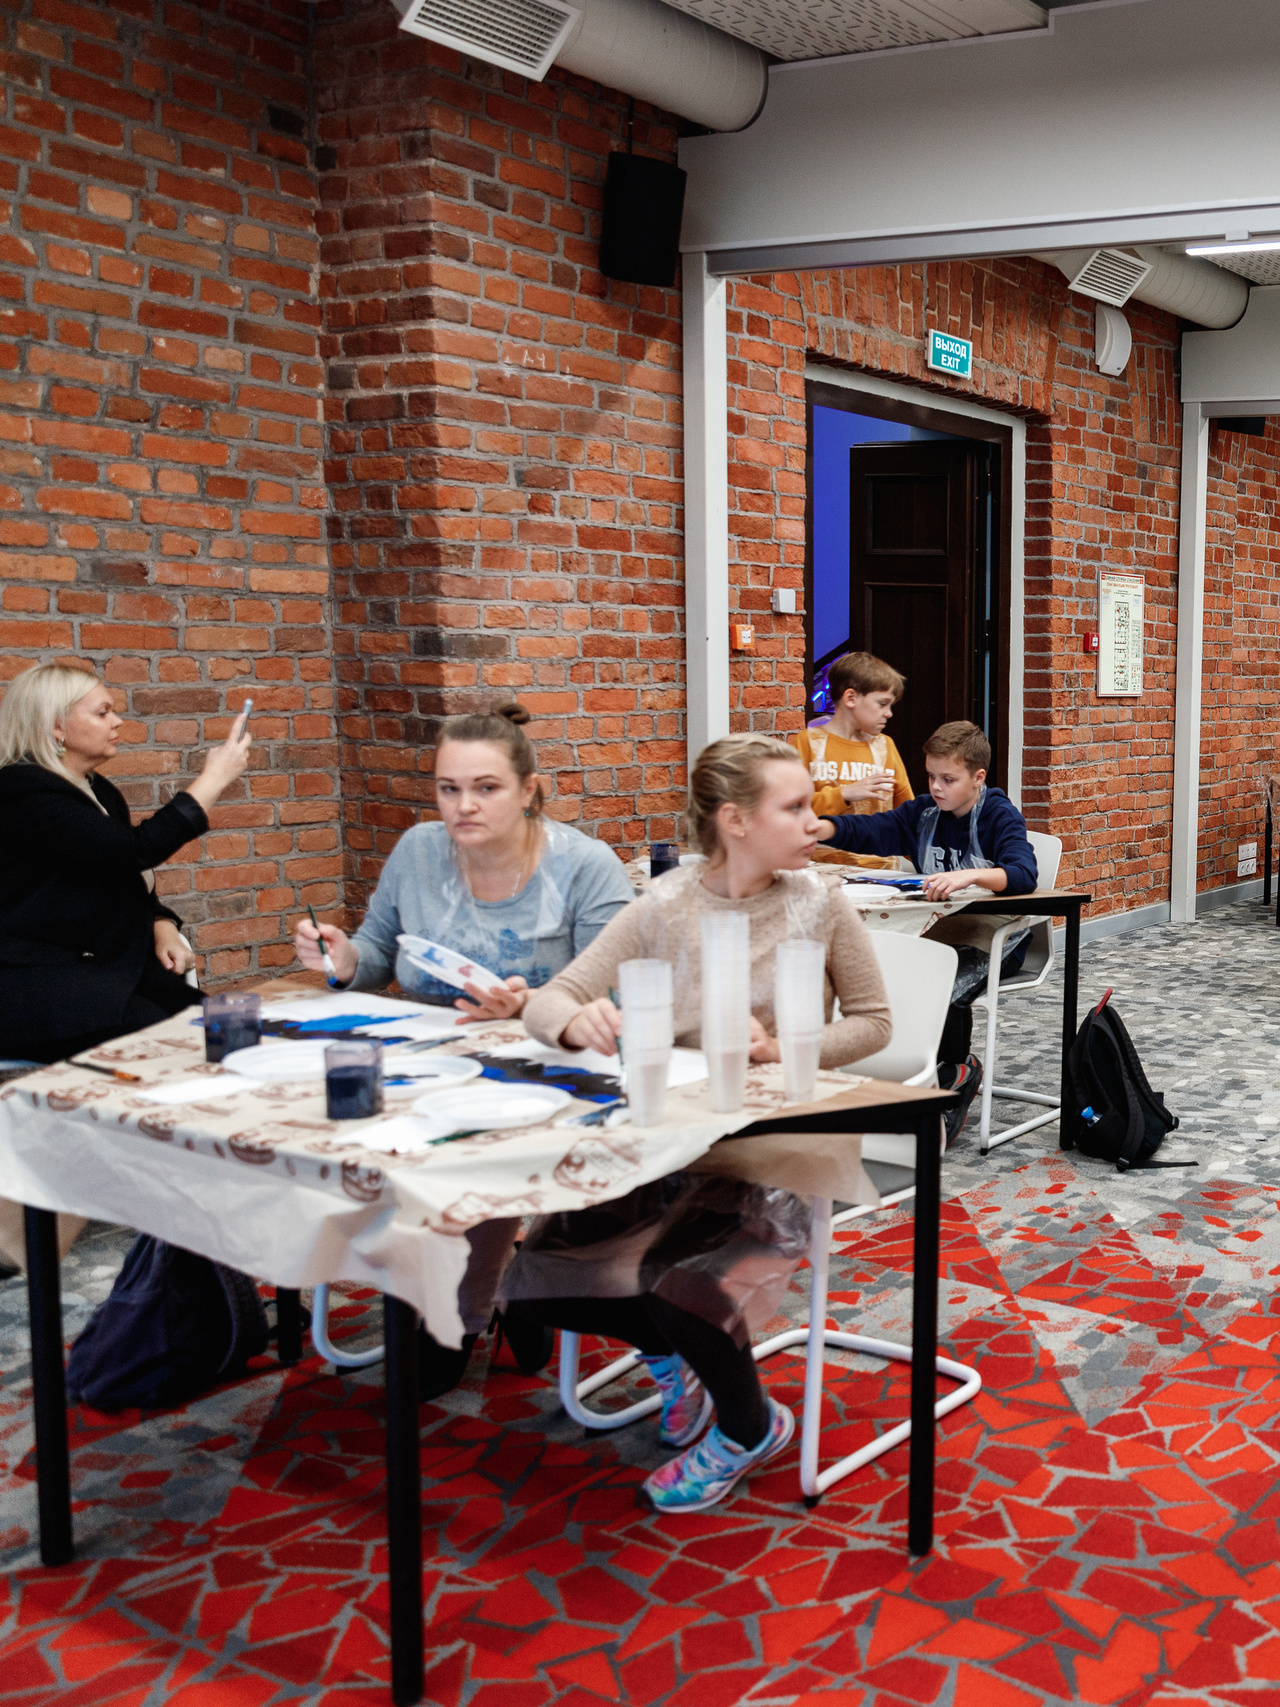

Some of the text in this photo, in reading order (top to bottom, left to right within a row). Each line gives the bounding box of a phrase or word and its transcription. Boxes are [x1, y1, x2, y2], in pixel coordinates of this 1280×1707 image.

[935, 336, 967, 360] ВЫХОД
[941, 354, 960, 370] EXIT
[810, 761, 838, 781] LOS
